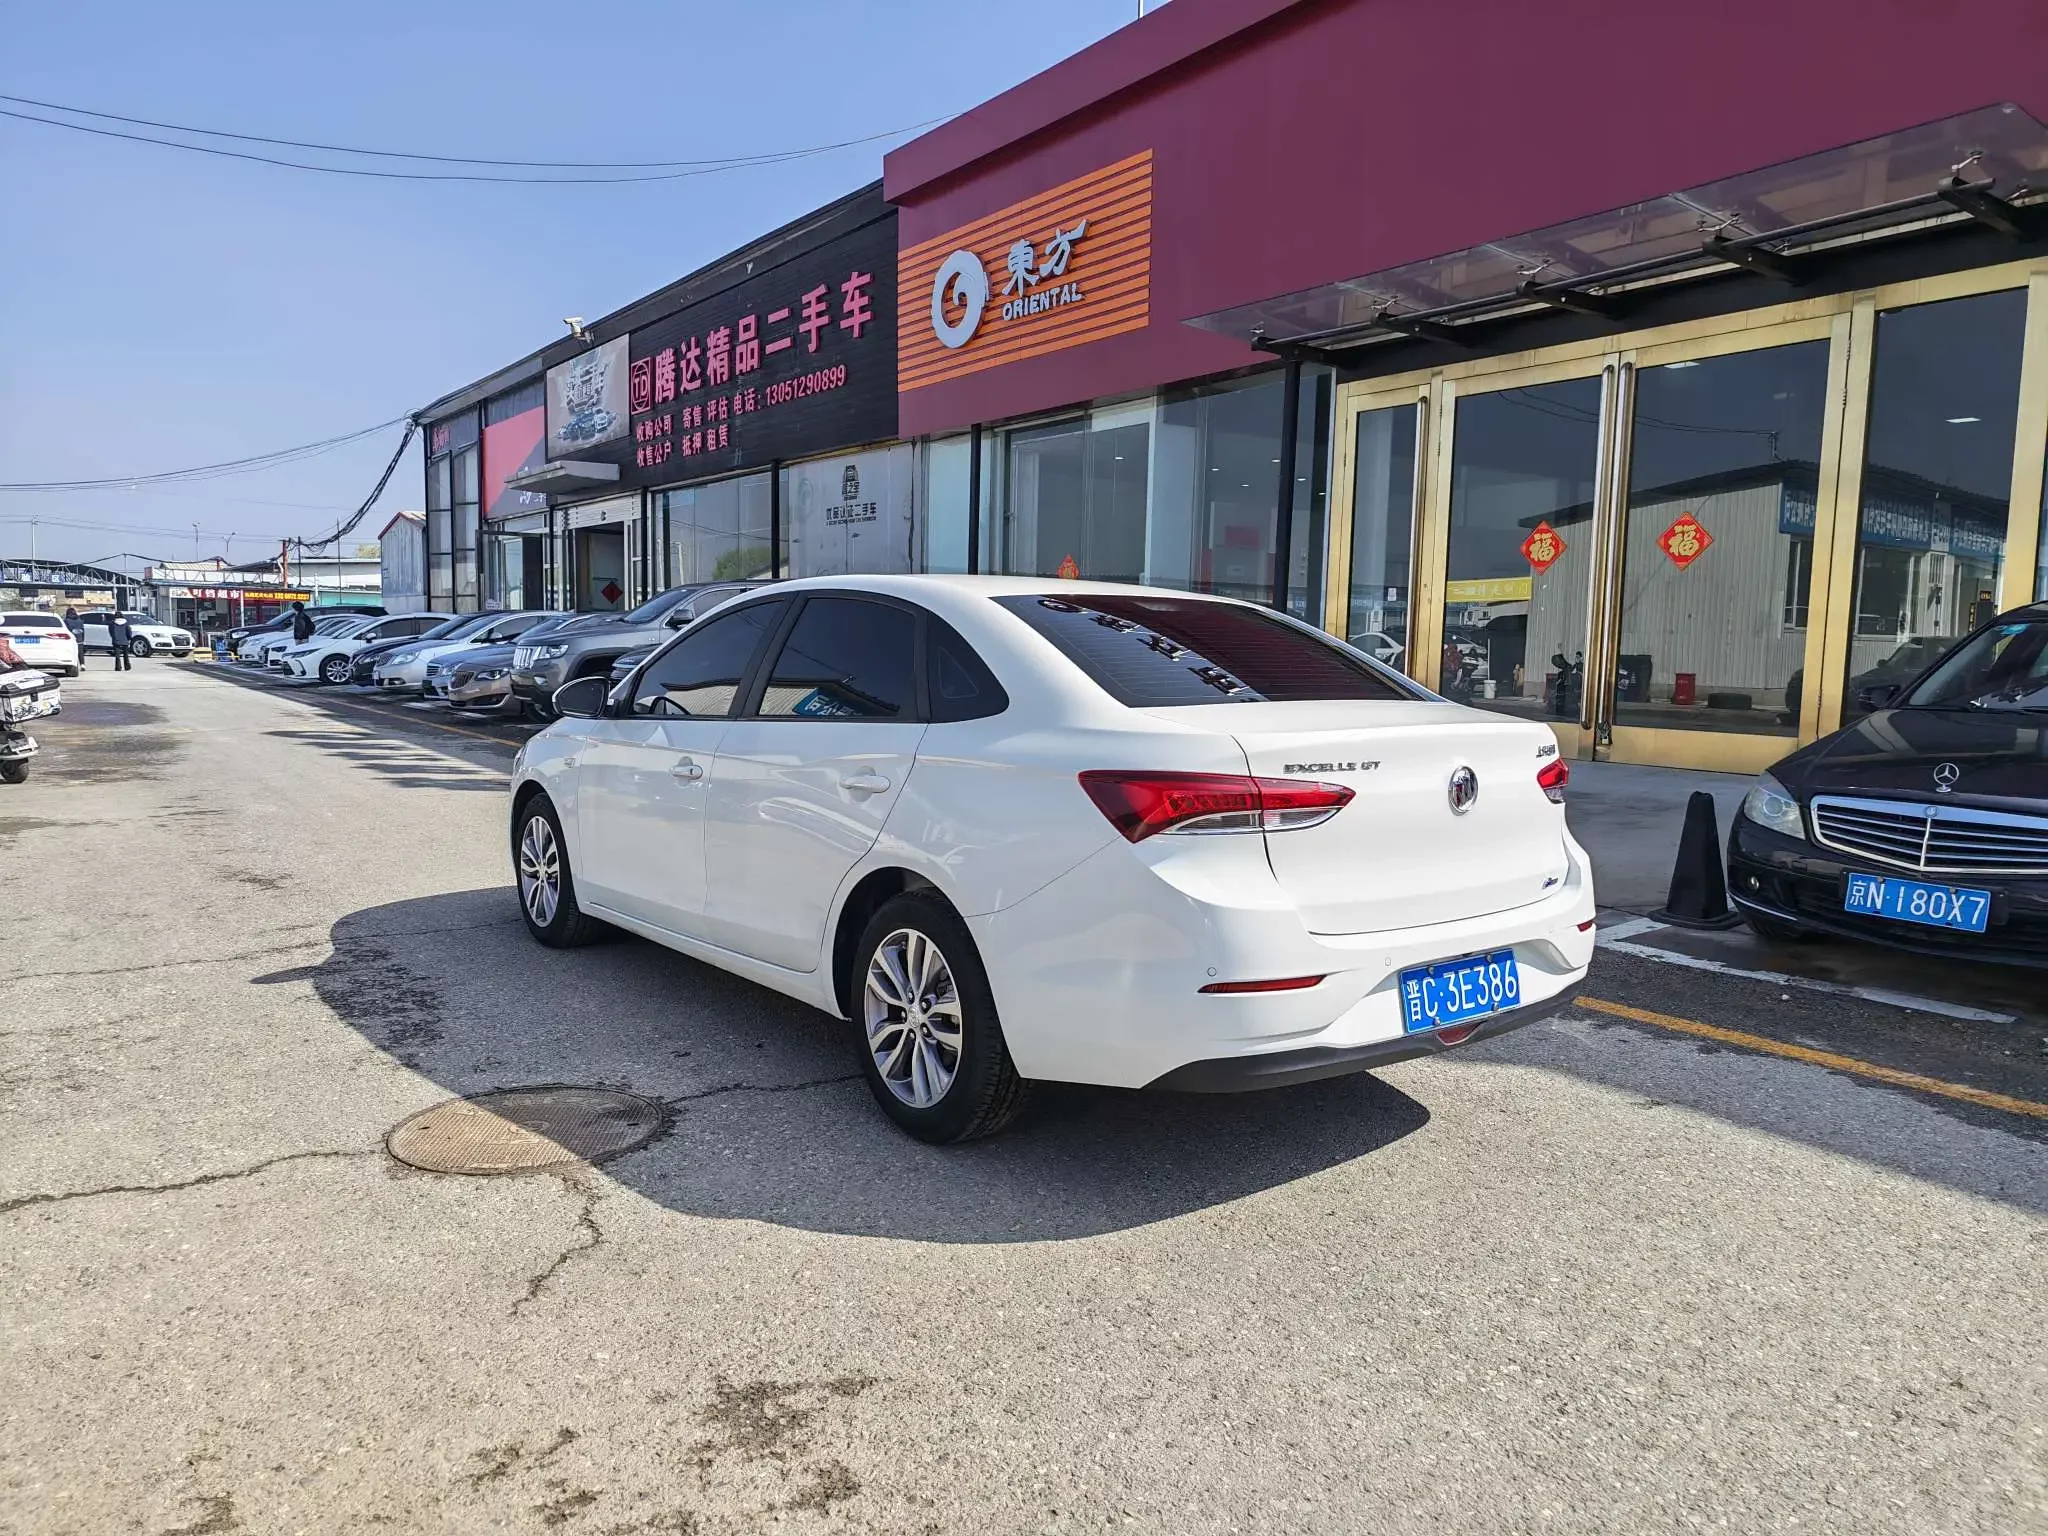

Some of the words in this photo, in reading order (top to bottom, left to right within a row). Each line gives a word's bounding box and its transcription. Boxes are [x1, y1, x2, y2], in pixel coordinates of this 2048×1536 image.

[1002, 282, 1085, 321] ORIENTAL
[655, 271, 874, 404] 腾达精品二手车
[636, 414, 672, 442] 收购公司
[682, 405, 703, 430] 寄售
[706, 396, 729, 422] 评估
[636, 439, 672, 468] 收售公户
[682, 432, 703, 457] 抵押
[707, 423, 729, 451] 租赁
[1529, 532, 1555, 562] 福
[1668, 524, 1700, 556] 福
[1283, 762, 1357, 775] EXCELLE
[1361, 760, 1381, 771] GT
